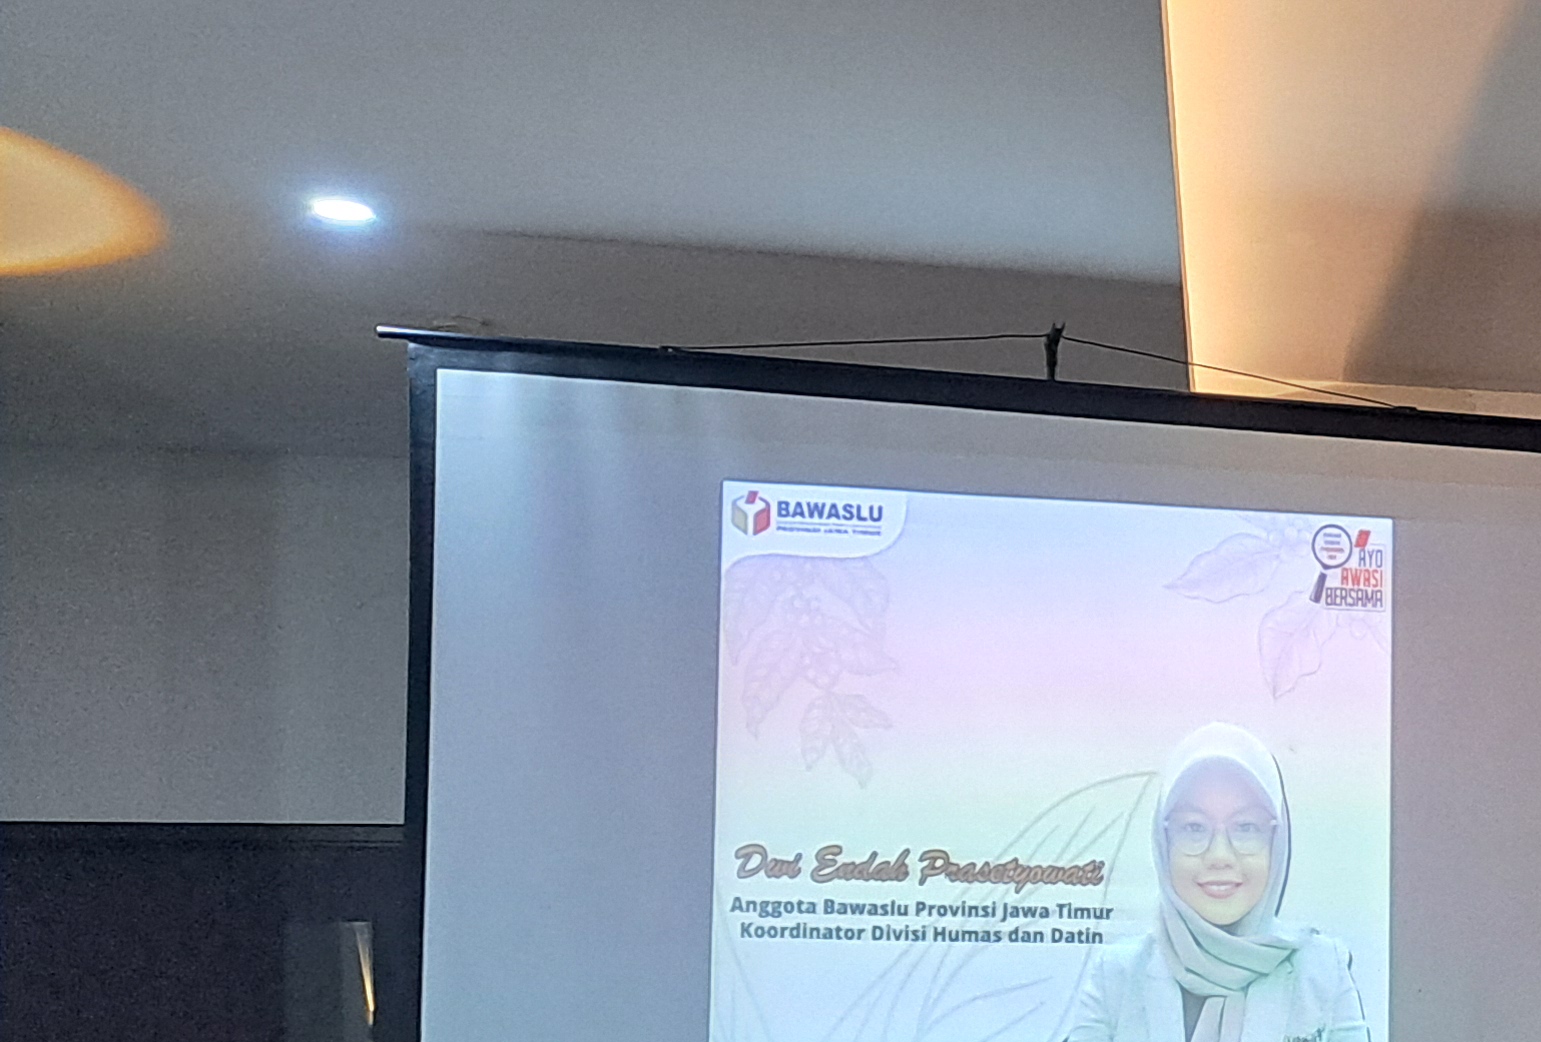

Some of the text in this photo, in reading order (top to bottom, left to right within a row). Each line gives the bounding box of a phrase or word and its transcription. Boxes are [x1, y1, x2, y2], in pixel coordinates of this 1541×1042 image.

[776, 500, 884, 523] BAWASLU
[1358, 549, 1383, 568] AYO
[1341, 567, 1383, 588] AWASI
[1325, 587, 1383, 608] BERSAMA
[734, 843, 803, 880] Dwi
[810, 845, 911, 884] Endah
[730, 896, 1114, 922] Anggota Bawaslu Provinsi Jawa Timur
[740, 921, 1103, 944] Koordinator Divisi Humas dan Datin
